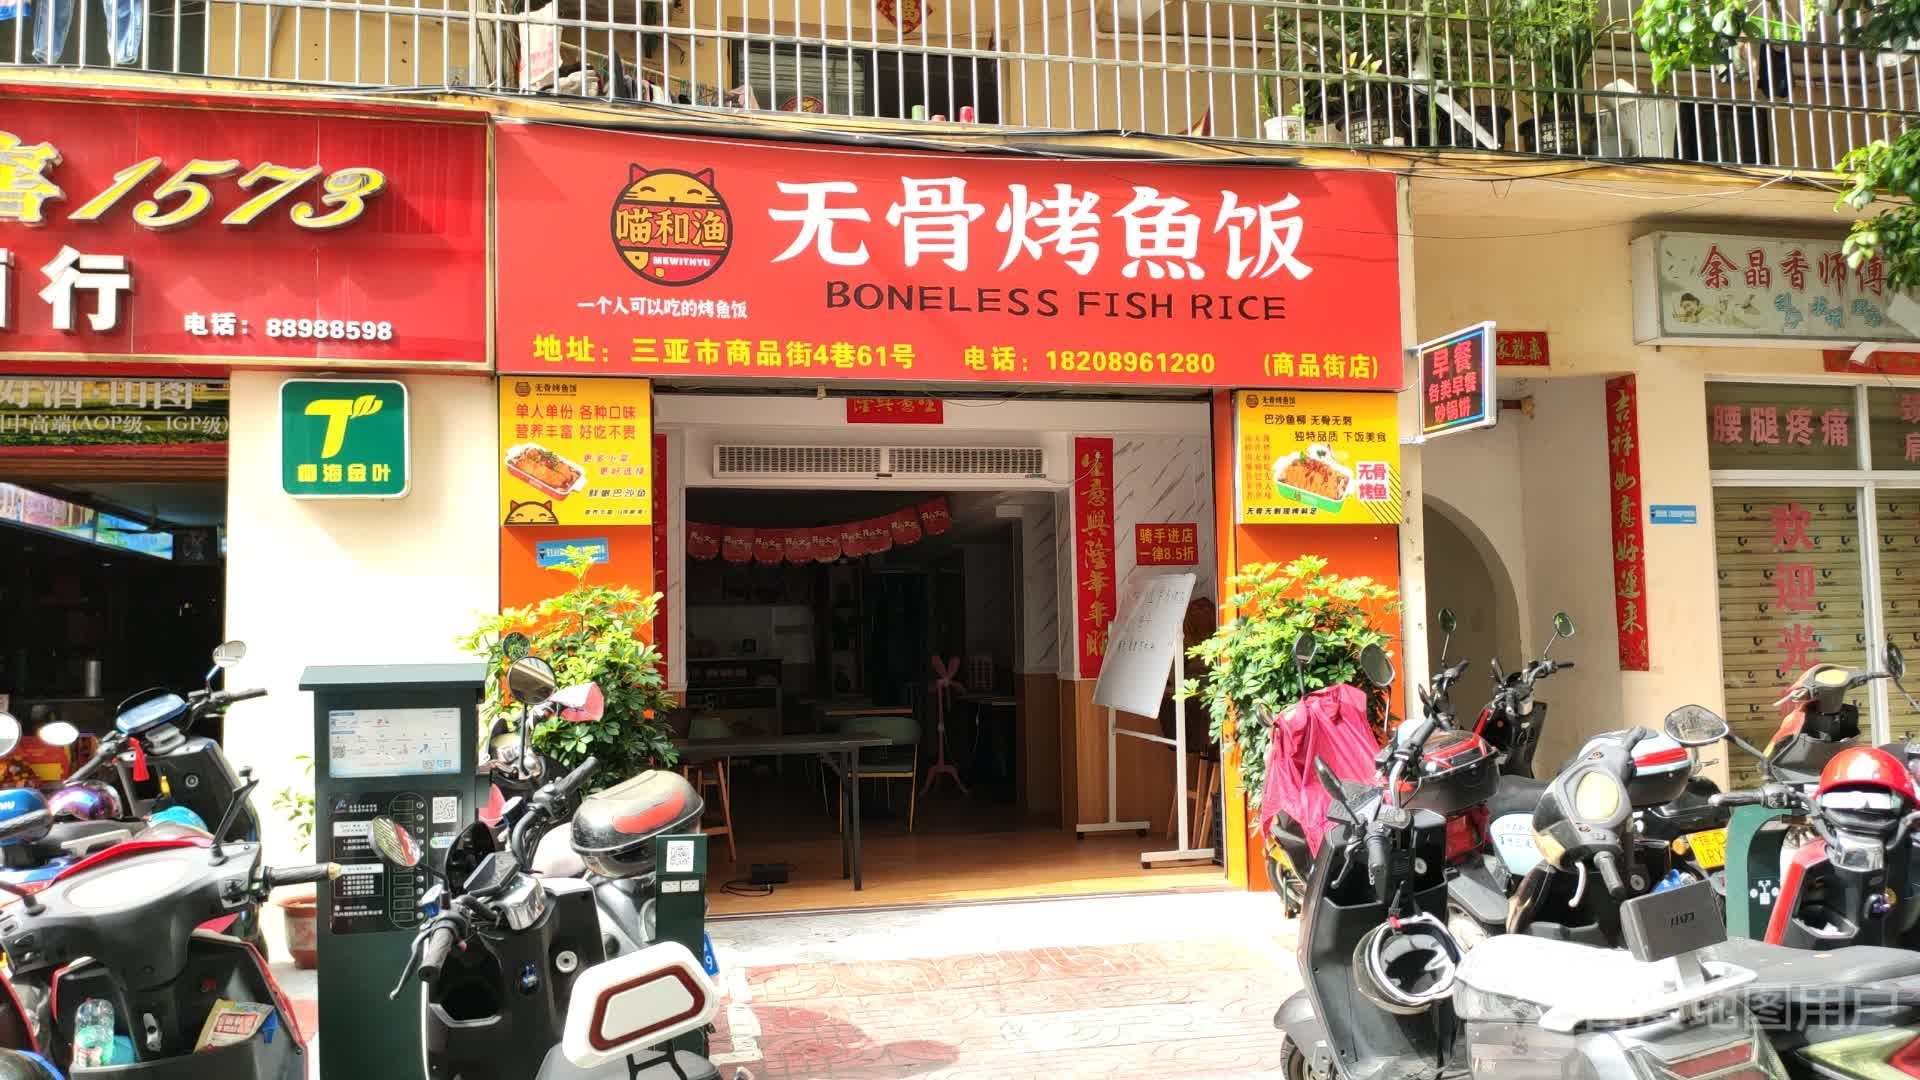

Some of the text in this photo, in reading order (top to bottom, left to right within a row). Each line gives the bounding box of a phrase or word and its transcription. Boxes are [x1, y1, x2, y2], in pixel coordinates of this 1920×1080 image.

[616, 207, 727, 247] 喵和渔
[0, 244, 130, 331] 行
[577, 296, 748, 320] 一个人可以吃的烤鱼饭
[827, 281, 1287, 320] BONELESS FISH RICE
[1433, 340, 1471, 379] 早餐
[1429, 372, 1477, 403] 各类早餐
[516, 404, 636, 420] 单人单份 各种口味
[516, 424, 636, 439] 营养丰富 好吃不贵
[1295, 431, 1387, 442] 独特品质 下饭美食
[1712, 405, 1848, 447] 腰腿疼痛
[1358, 464, 1387, 480] 无骨
[1358, 483, 1387, 500] 烤鱼
[1139, 528, 1193, 544] 骑手进店
[1139, 545, 1194, 562] 一律8.5折
[1769, 501, 1819, 718] 欢迎光
